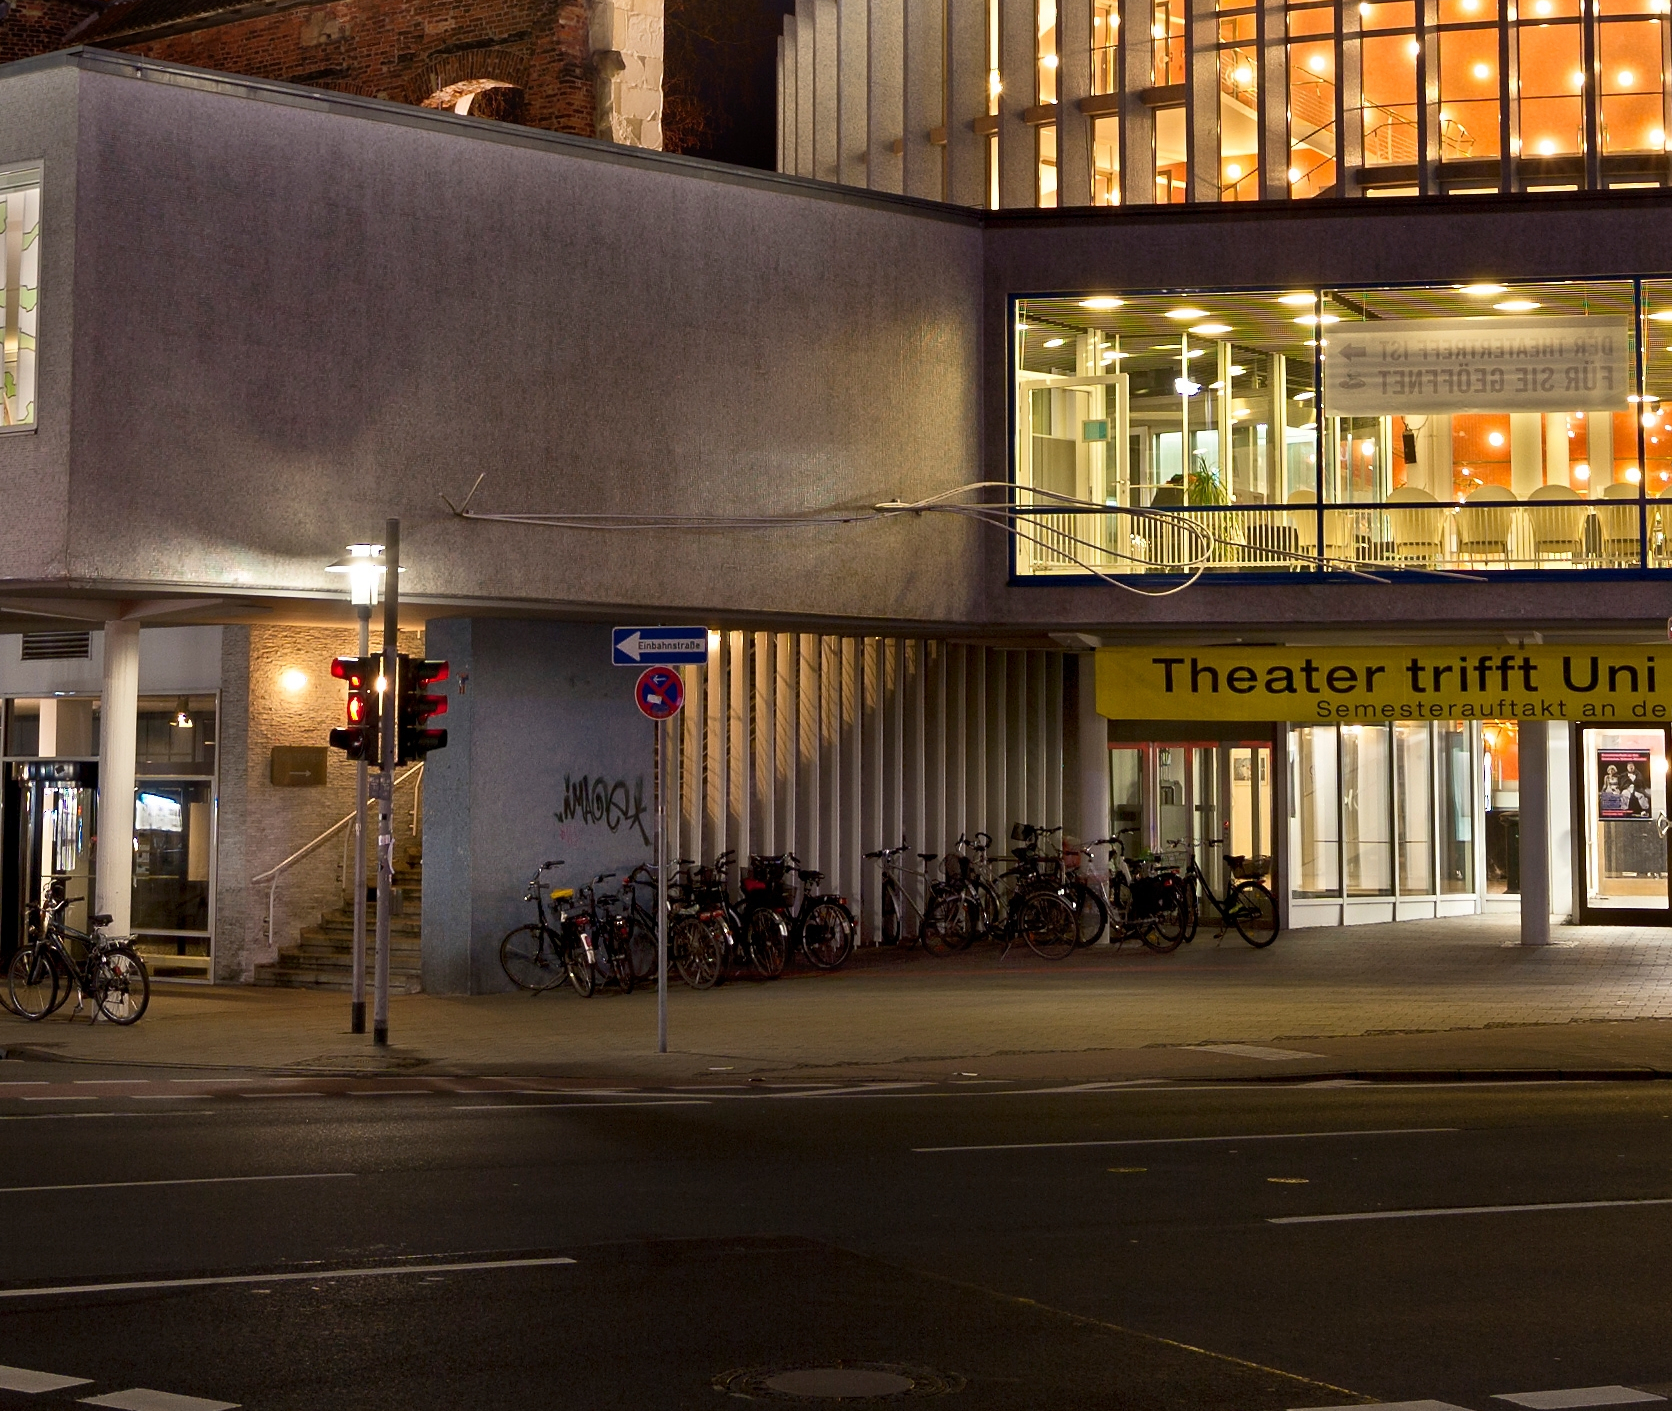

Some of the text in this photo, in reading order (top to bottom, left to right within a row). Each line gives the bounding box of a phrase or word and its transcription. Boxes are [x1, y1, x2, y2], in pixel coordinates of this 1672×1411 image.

[638, 641, 701, 651] Einbahnstraße
[1152, 657, 1386, 694] Theater
[1406, 655, 1538, 693] trifft
[1562, 655, 1656, 693] Uni
[1317, 699, 1567, 718] Semesterauftakt
[1582, 704, 1616, 717] an
